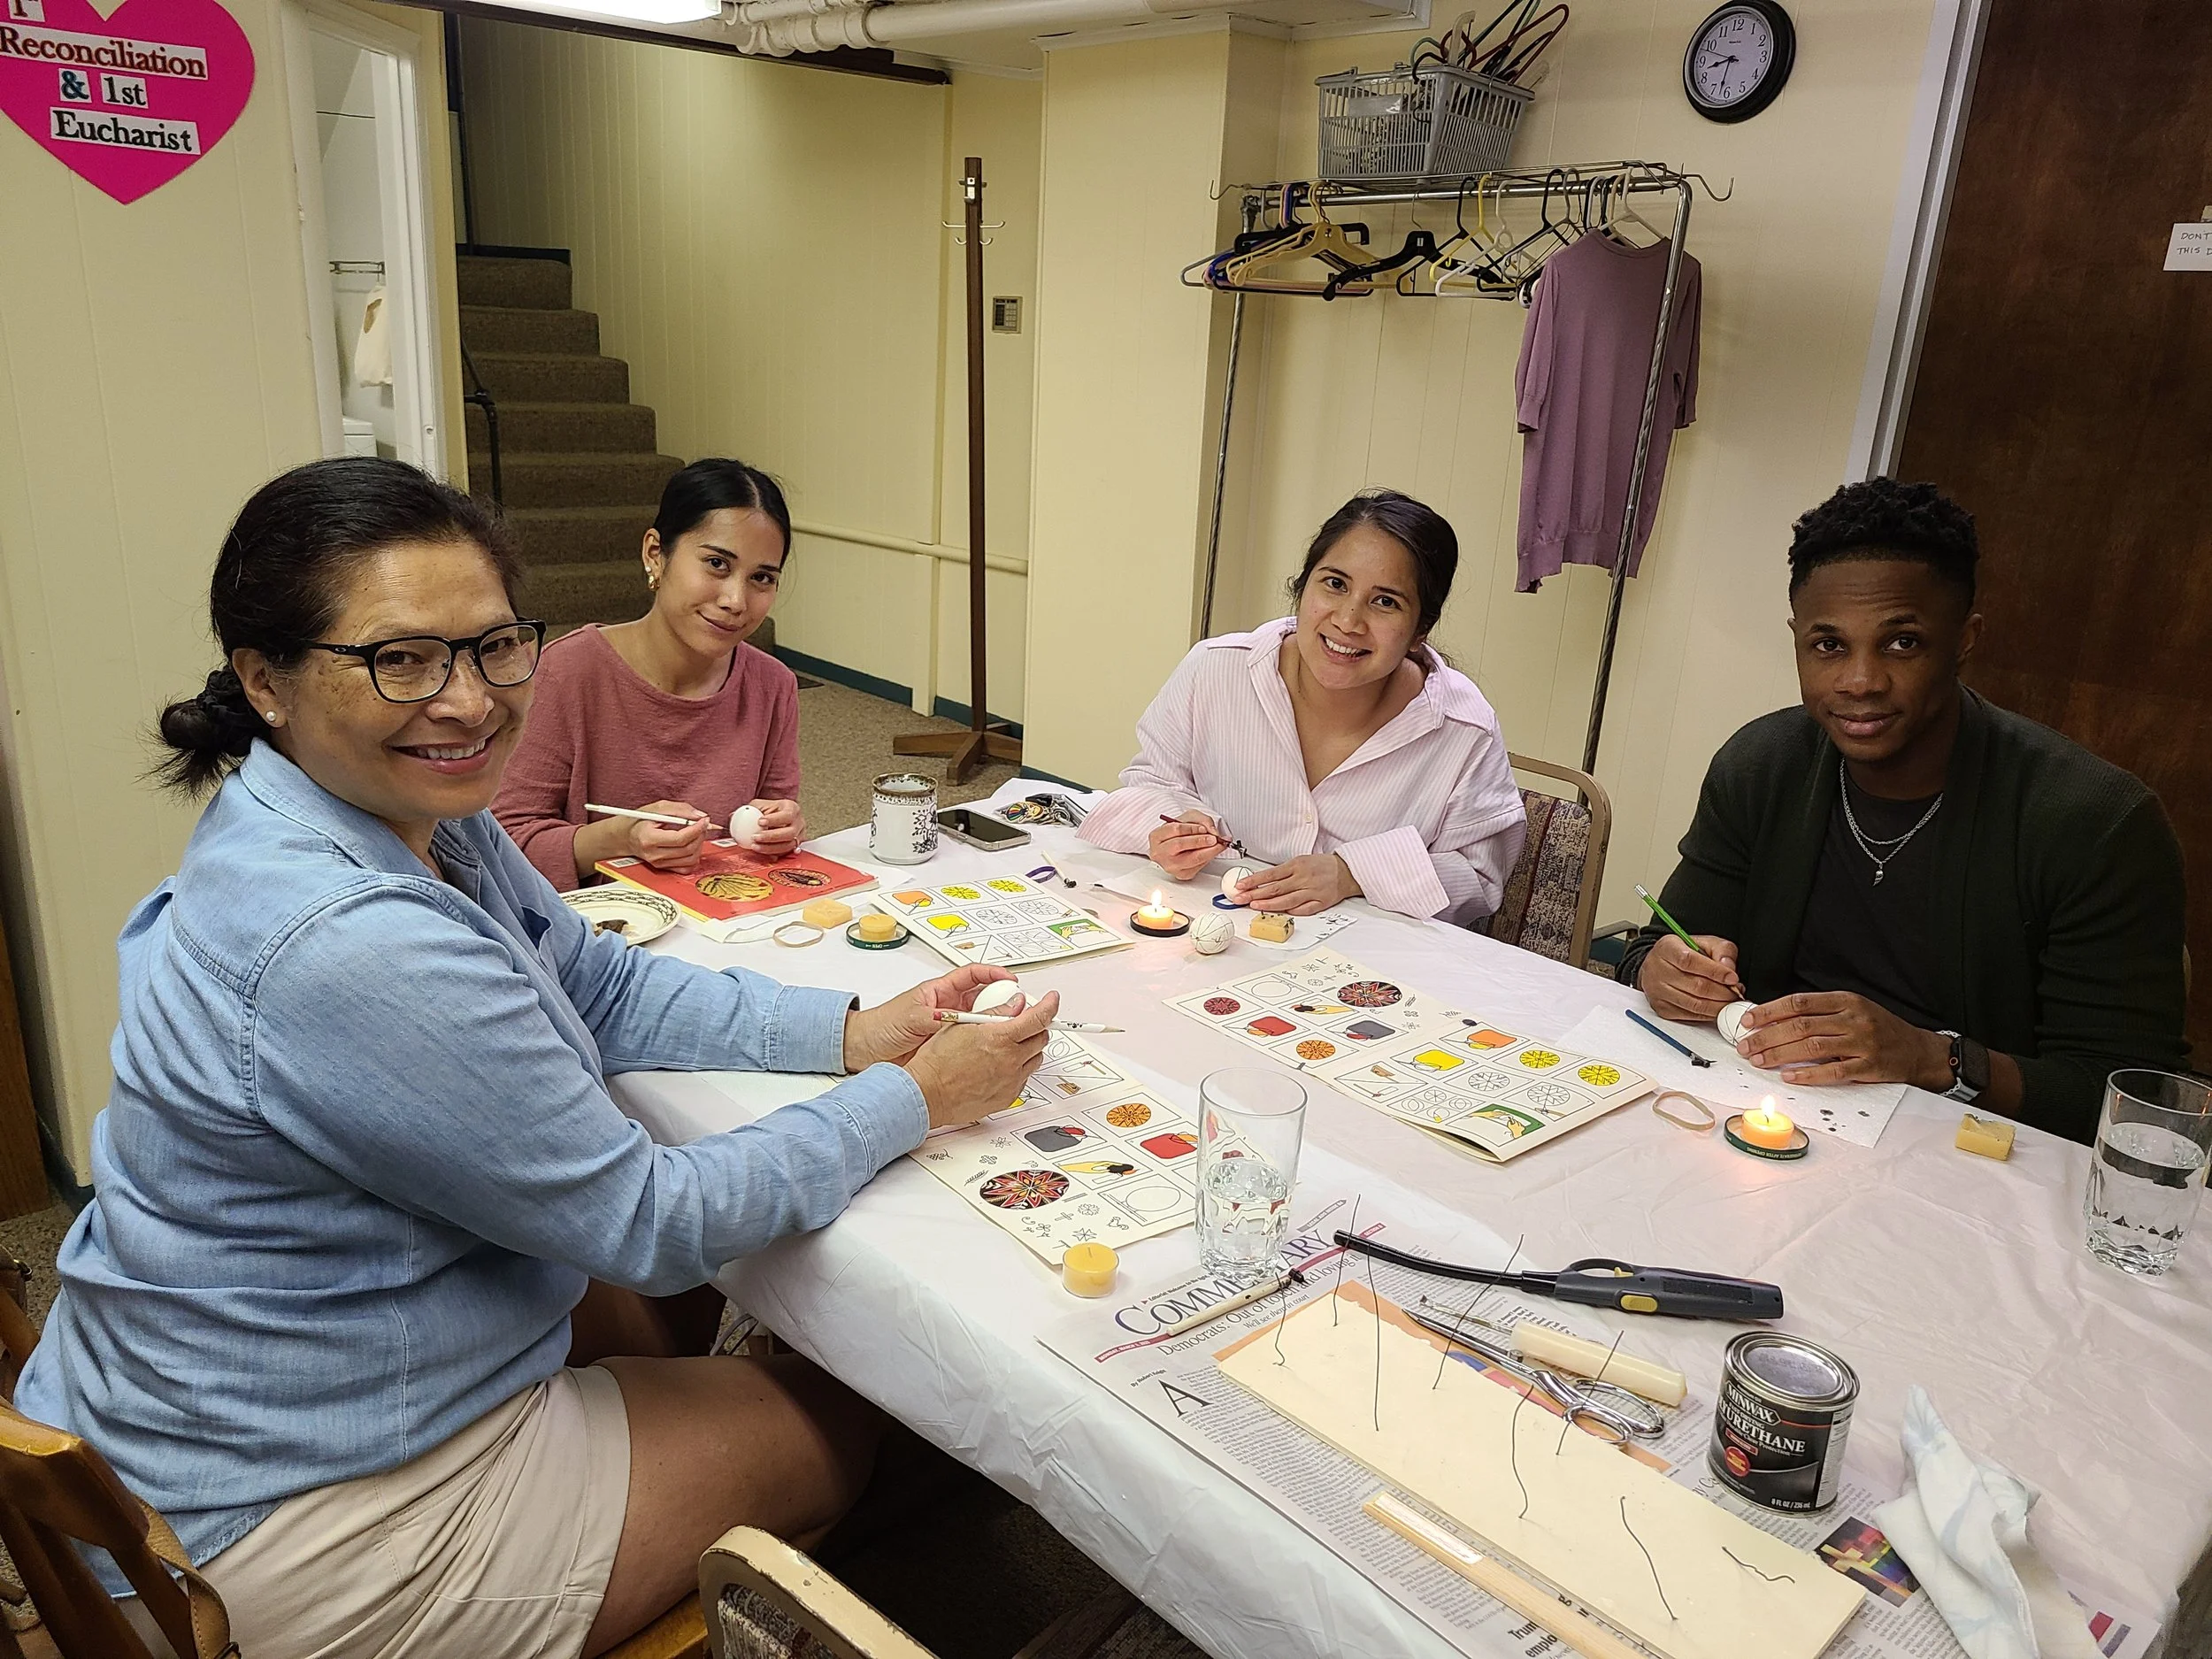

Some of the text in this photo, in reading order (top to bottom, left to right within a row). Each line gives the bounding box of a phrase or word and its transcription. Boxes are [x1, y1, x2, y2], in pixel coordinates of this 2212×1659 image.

[1719, 26, 1728, 38] 11
[1732, 19, 1745, 32] 12
[1750, 23, 1756, 35] 1
[1706, 39, 1717, 51] 10
[1757, 35, 1767, 48] 2
[0, 26, 206, 78] Reconciliation
[1759, 50, 1768, 63] 3
[1698, 56, 1707, 68] 9
[1701, 72, 1708, 84] 8
[1751, 68, 1759, 80] 4
[61, 70, 146, 106] & 1st
[1710, 83, 1717, 96] 7
[1723, 87, 1731, 99] 6
[1739, 81, 1747, 94] 5
[52, 110, 192, 152] Eucharist
[1115, 1229, 1333, 1335] COMMEARY
[1156, 1322, 1231, 1356] Democrats:
[1225, 1308, 1255, 1324] Out
[1265, 1284, 1300, 1307] touch
[1299, 1271, 1321, 1290] and
[1317, 1258, 1356, 1277] loving
[1158, 1379, 1213, 1417] A
[1728, 1384, 1775, 1424] MINWAX
[1507, 1620, 1540, 1641] Trum
[1525, 1633, 1558, 1658] emplo
